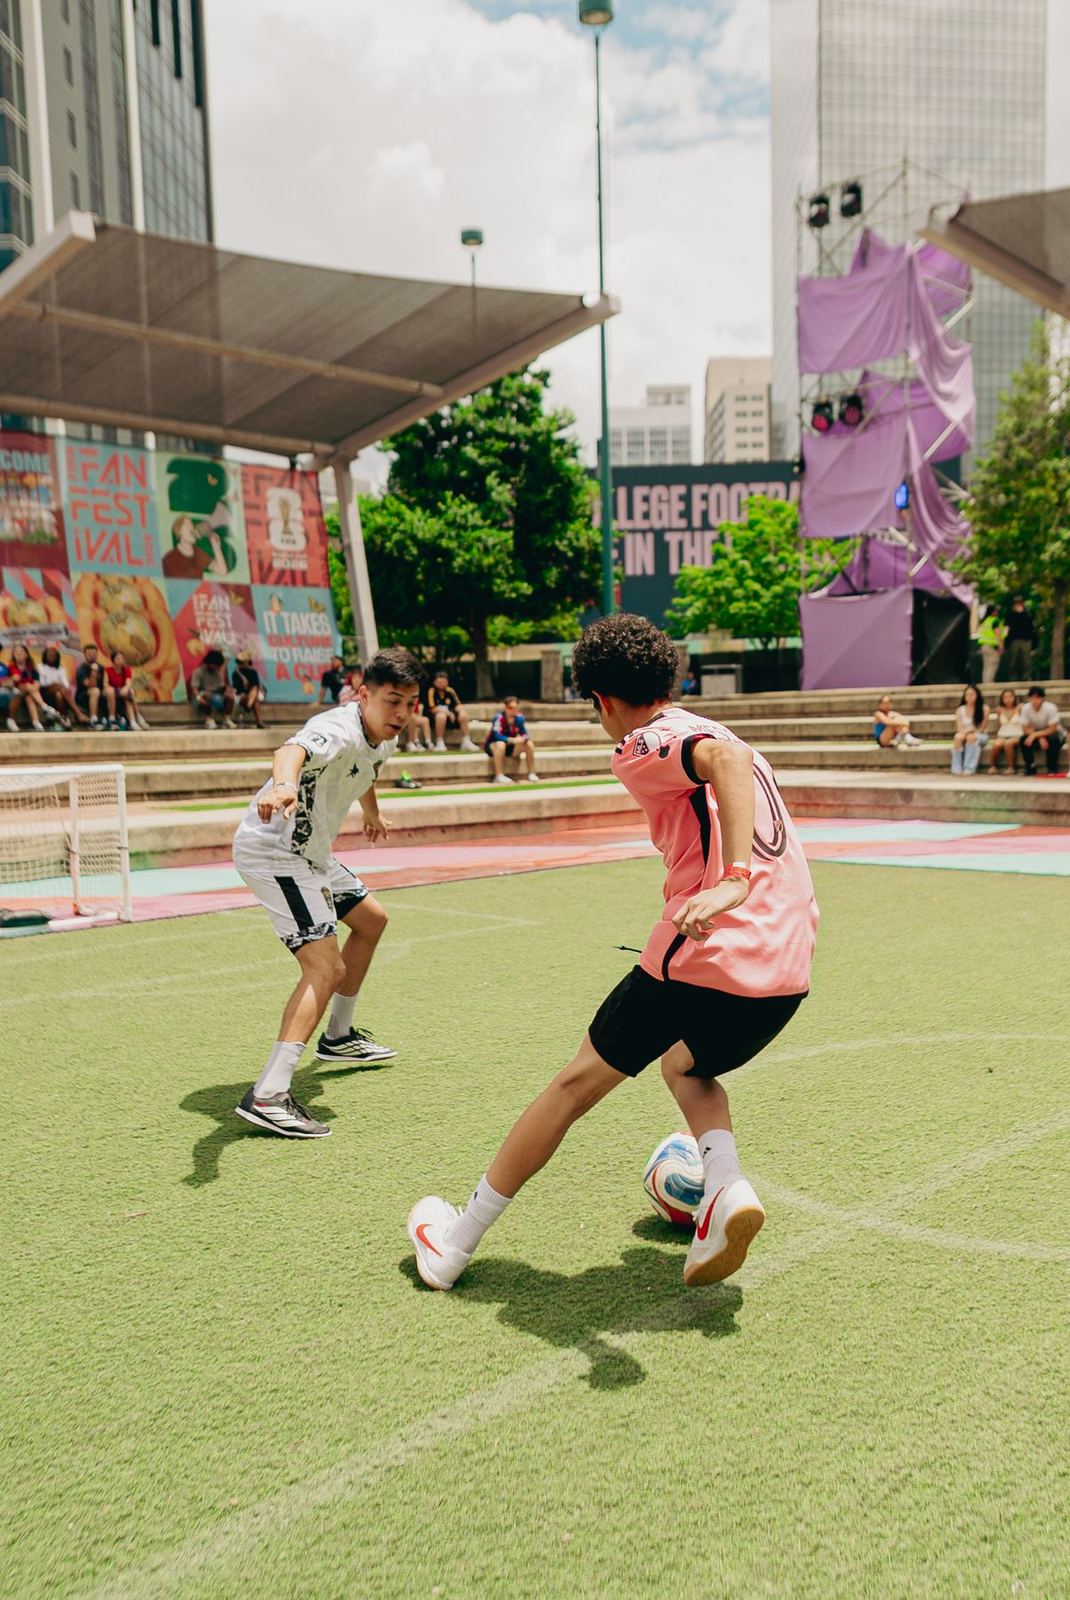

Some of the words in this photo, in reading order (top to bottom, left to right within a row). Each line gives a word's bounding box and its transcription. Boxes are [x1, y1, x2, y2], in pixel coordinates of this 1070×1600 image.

[79, 447, 148, 489] FAN
[69, 485, 151, 529] FEST
[692, 481, 800, 527] FOO
[624, 532, 655, 576] IN
[280, 611, 332, 636] TAKES
[275, 661, 291, 681] A
